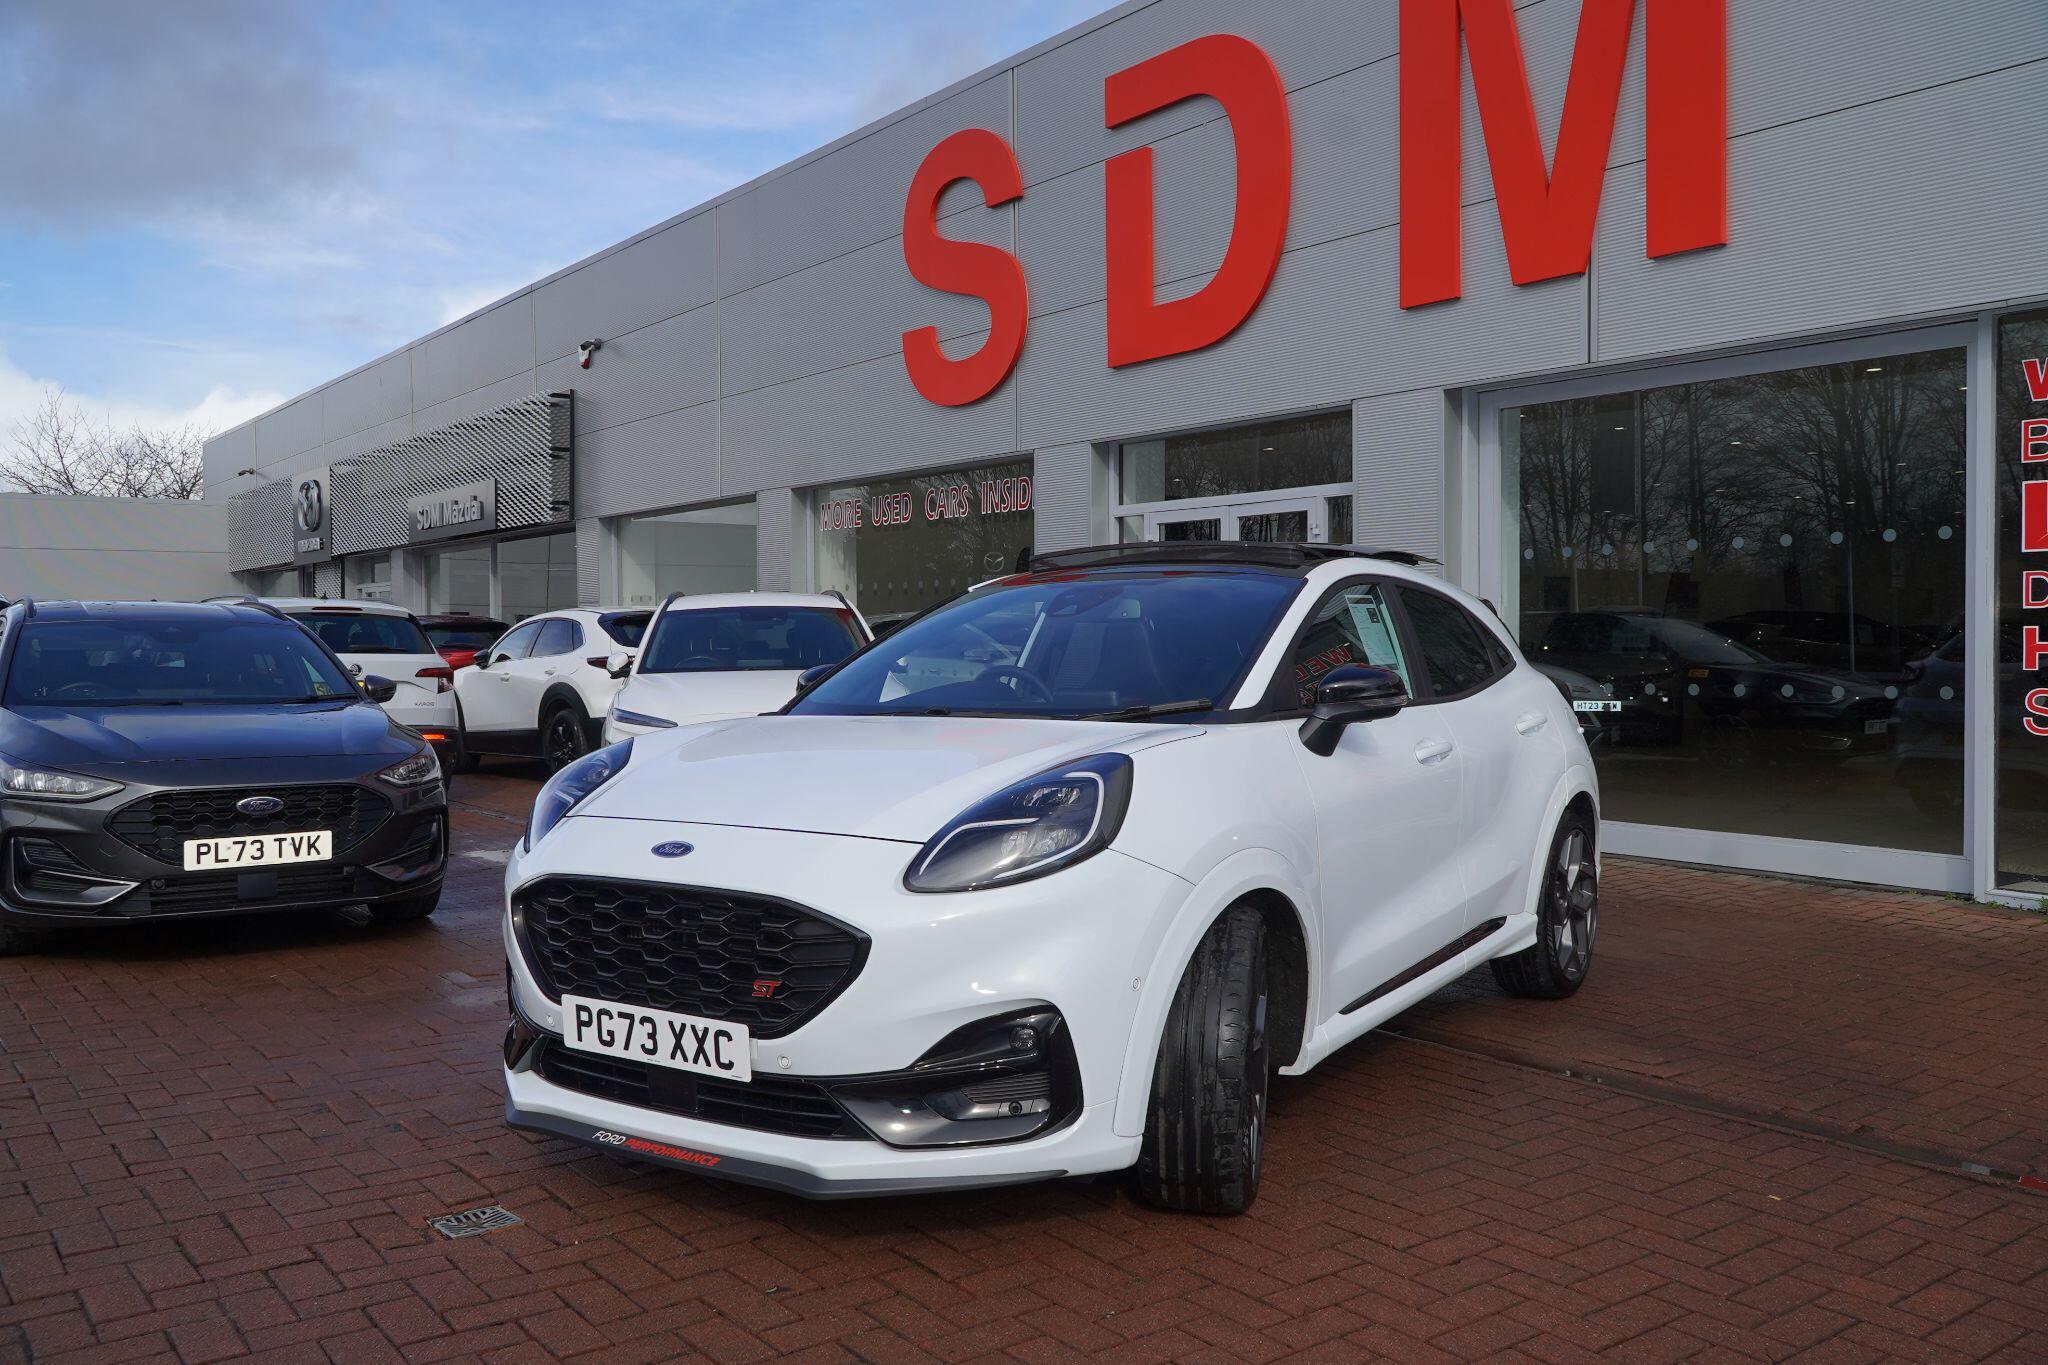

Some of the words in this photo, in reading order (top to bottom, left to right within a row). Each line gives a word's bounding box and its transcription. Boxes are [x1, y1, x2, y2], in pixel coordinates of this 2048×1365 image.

[902, 0, 1728, 406] SDM
[417, 503, 444, 530] SDM
[443, 495, 484, 525] Mazda
[821, 498, 862, 531] MORE
[871, 491, 913, 527] USED
[924, 483, 969, 521] CARS
[981, 475, 1035, 515] INSID
[196, 839, 264, 865] PL73
[274, 835, 321, 858] TVK
[752, 980, 782, 998] ST
[575, 1003, 659, 1056] PG73
[668, 1020, 735, 1071] XXC
[592, 1130, 626, 1145] FORD
[623, 1138, 721, 1167] PERFORMANCE
